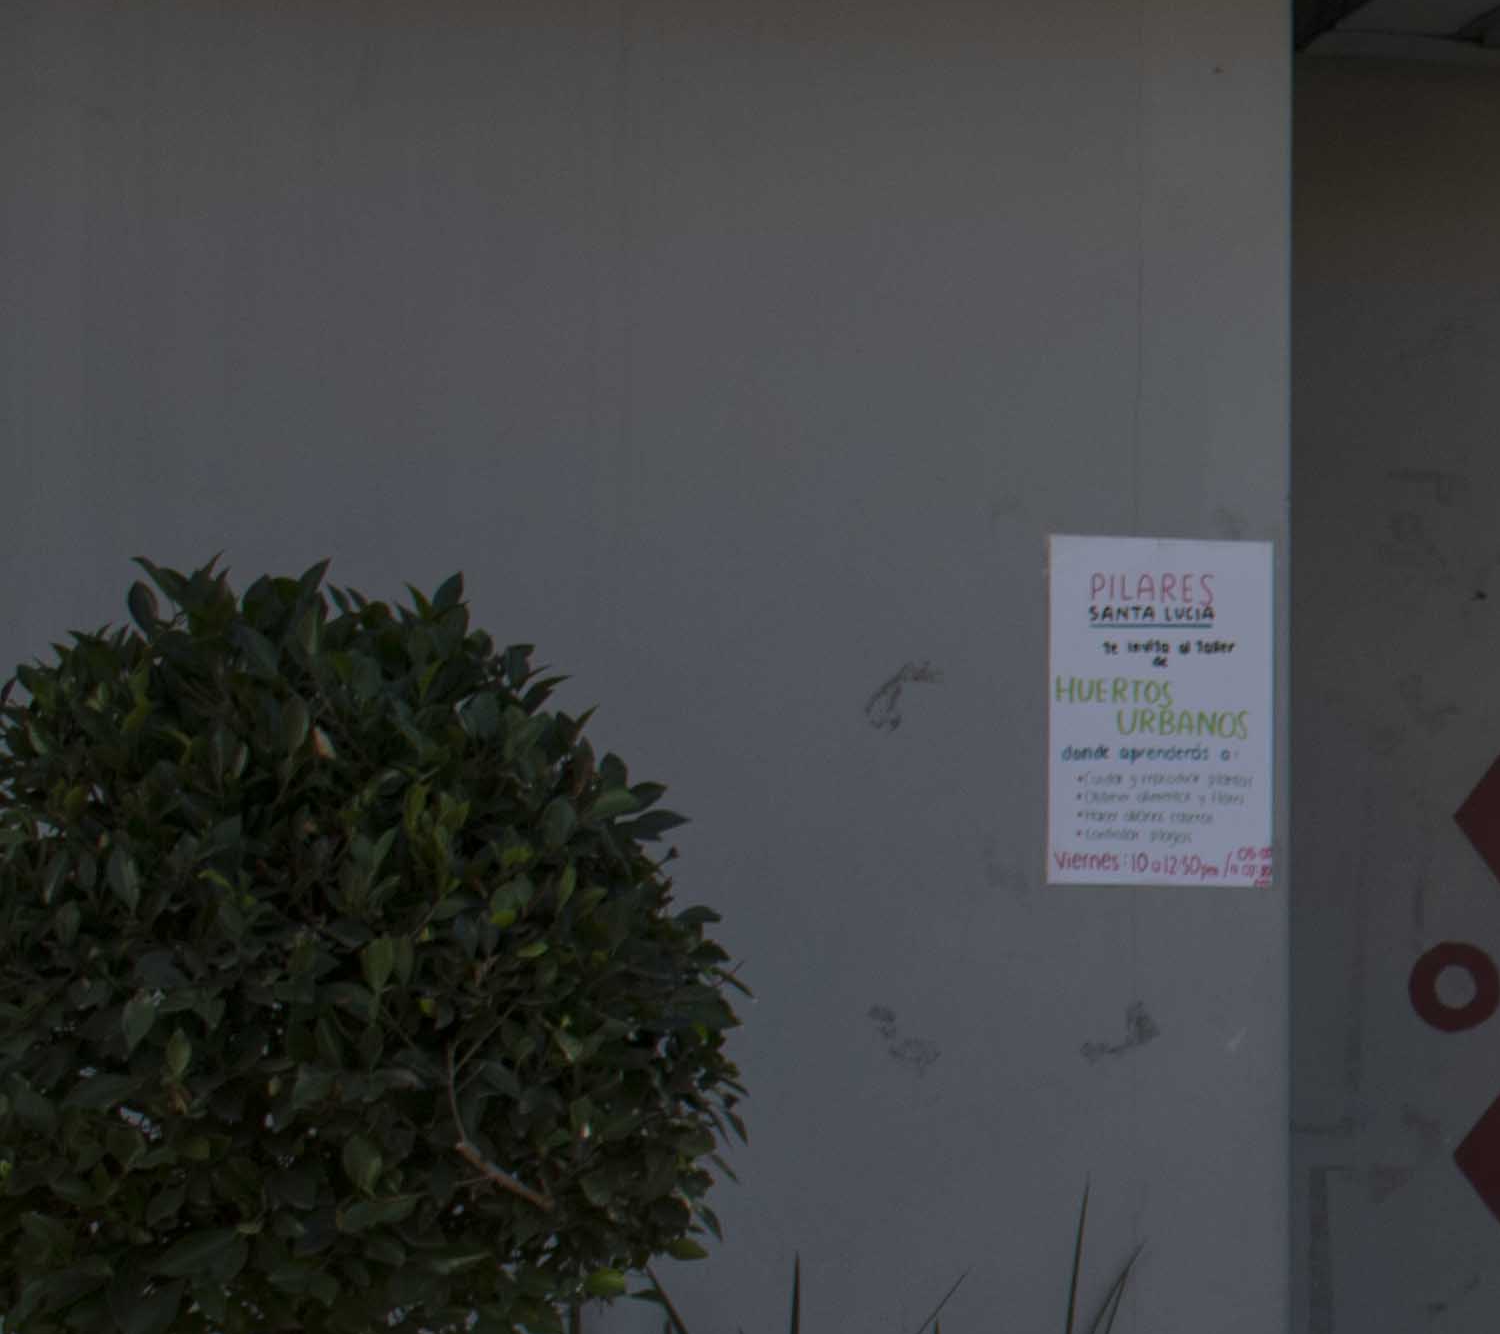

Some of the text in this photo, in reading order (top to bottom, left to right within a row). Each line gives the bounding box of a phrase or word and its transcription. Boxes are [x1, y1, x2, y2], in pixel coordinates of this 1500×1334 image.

[1090, 571, 1216, 606] PILARES
[1088, 605, 1156, 622] SANTA
[1055, 674, 1174, 709] HUERTOS
[1116, 707, 1250, 740] URBANOS
